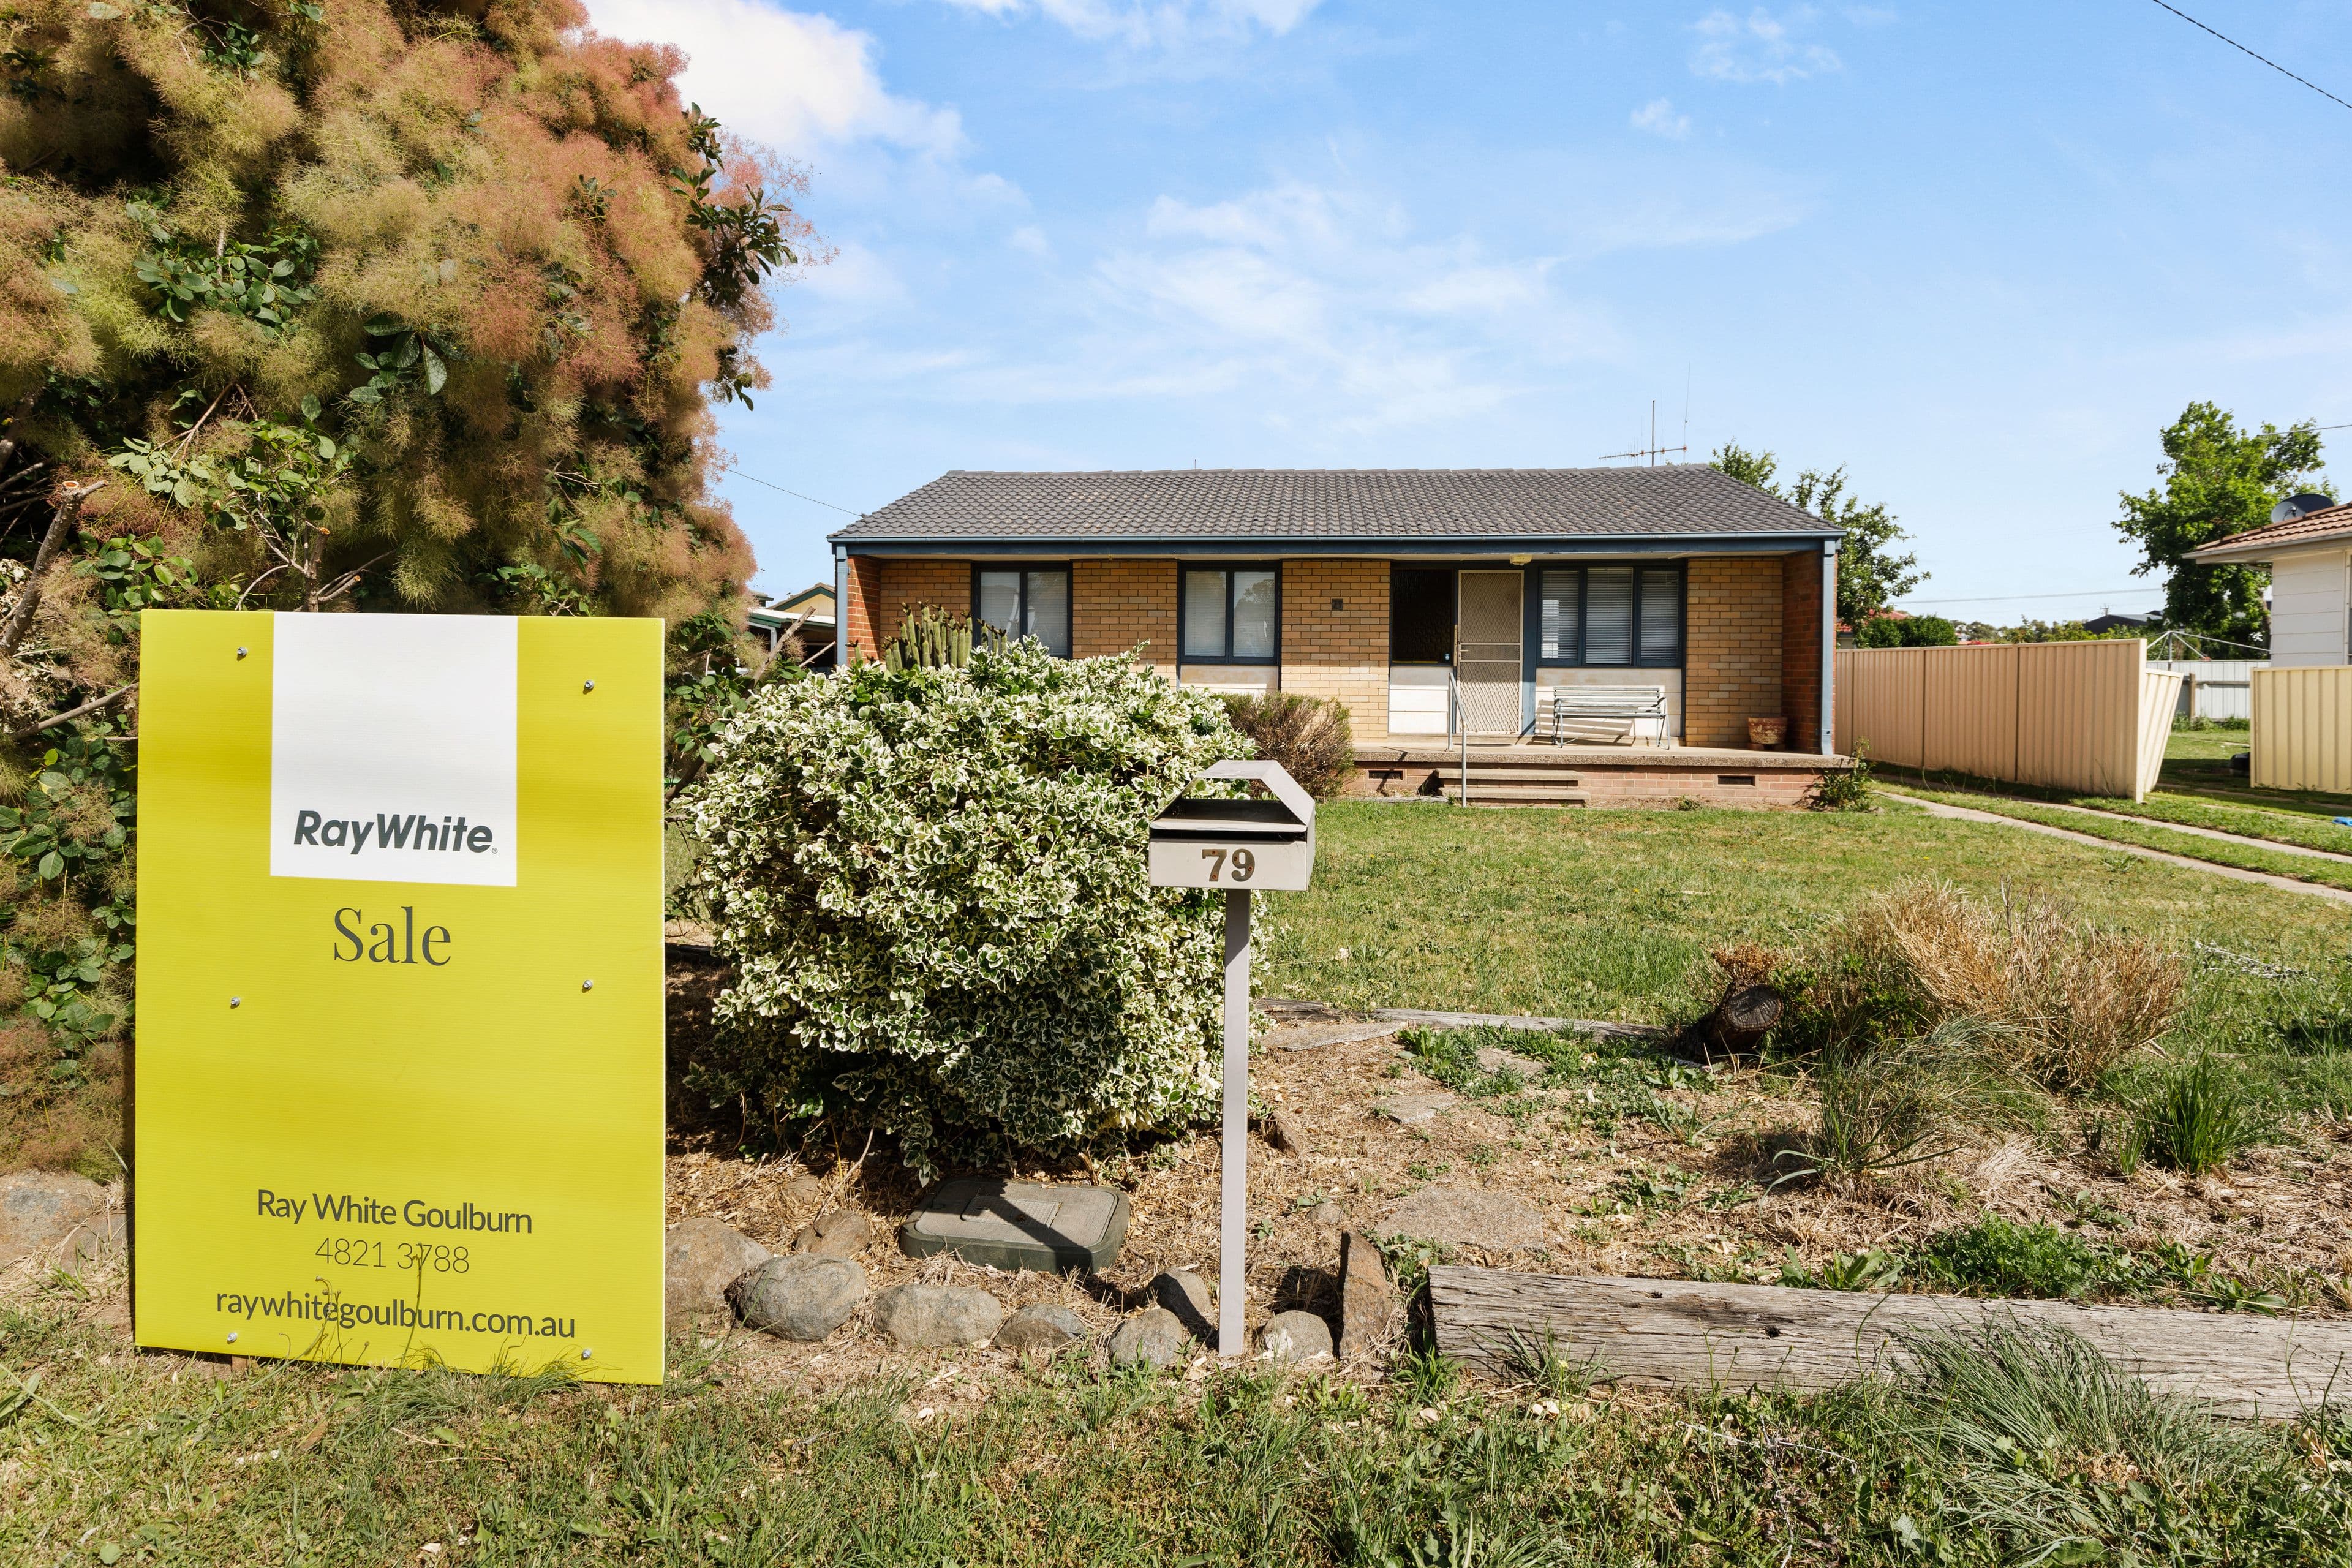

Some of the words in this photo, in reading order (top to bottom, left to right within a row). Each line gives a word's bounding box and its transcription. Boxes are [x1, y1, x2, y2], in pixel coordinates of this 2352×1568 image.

[293, 810, 493, 855] RayWhite
[1202, 848, 1256, 882] 79
[334, 907, 451, 967] Sale
[258, 1189, 307, 1224] Ray
[312, 1193, 397, 1225] White
[403, 1199, 532, 1234] Goulburn
[315, 1237, 386, 1268] 4821
[397, 1243, 470, 1273] 3788
[217, 1291, 575, 1338] raywhitegoulburn.com.au
